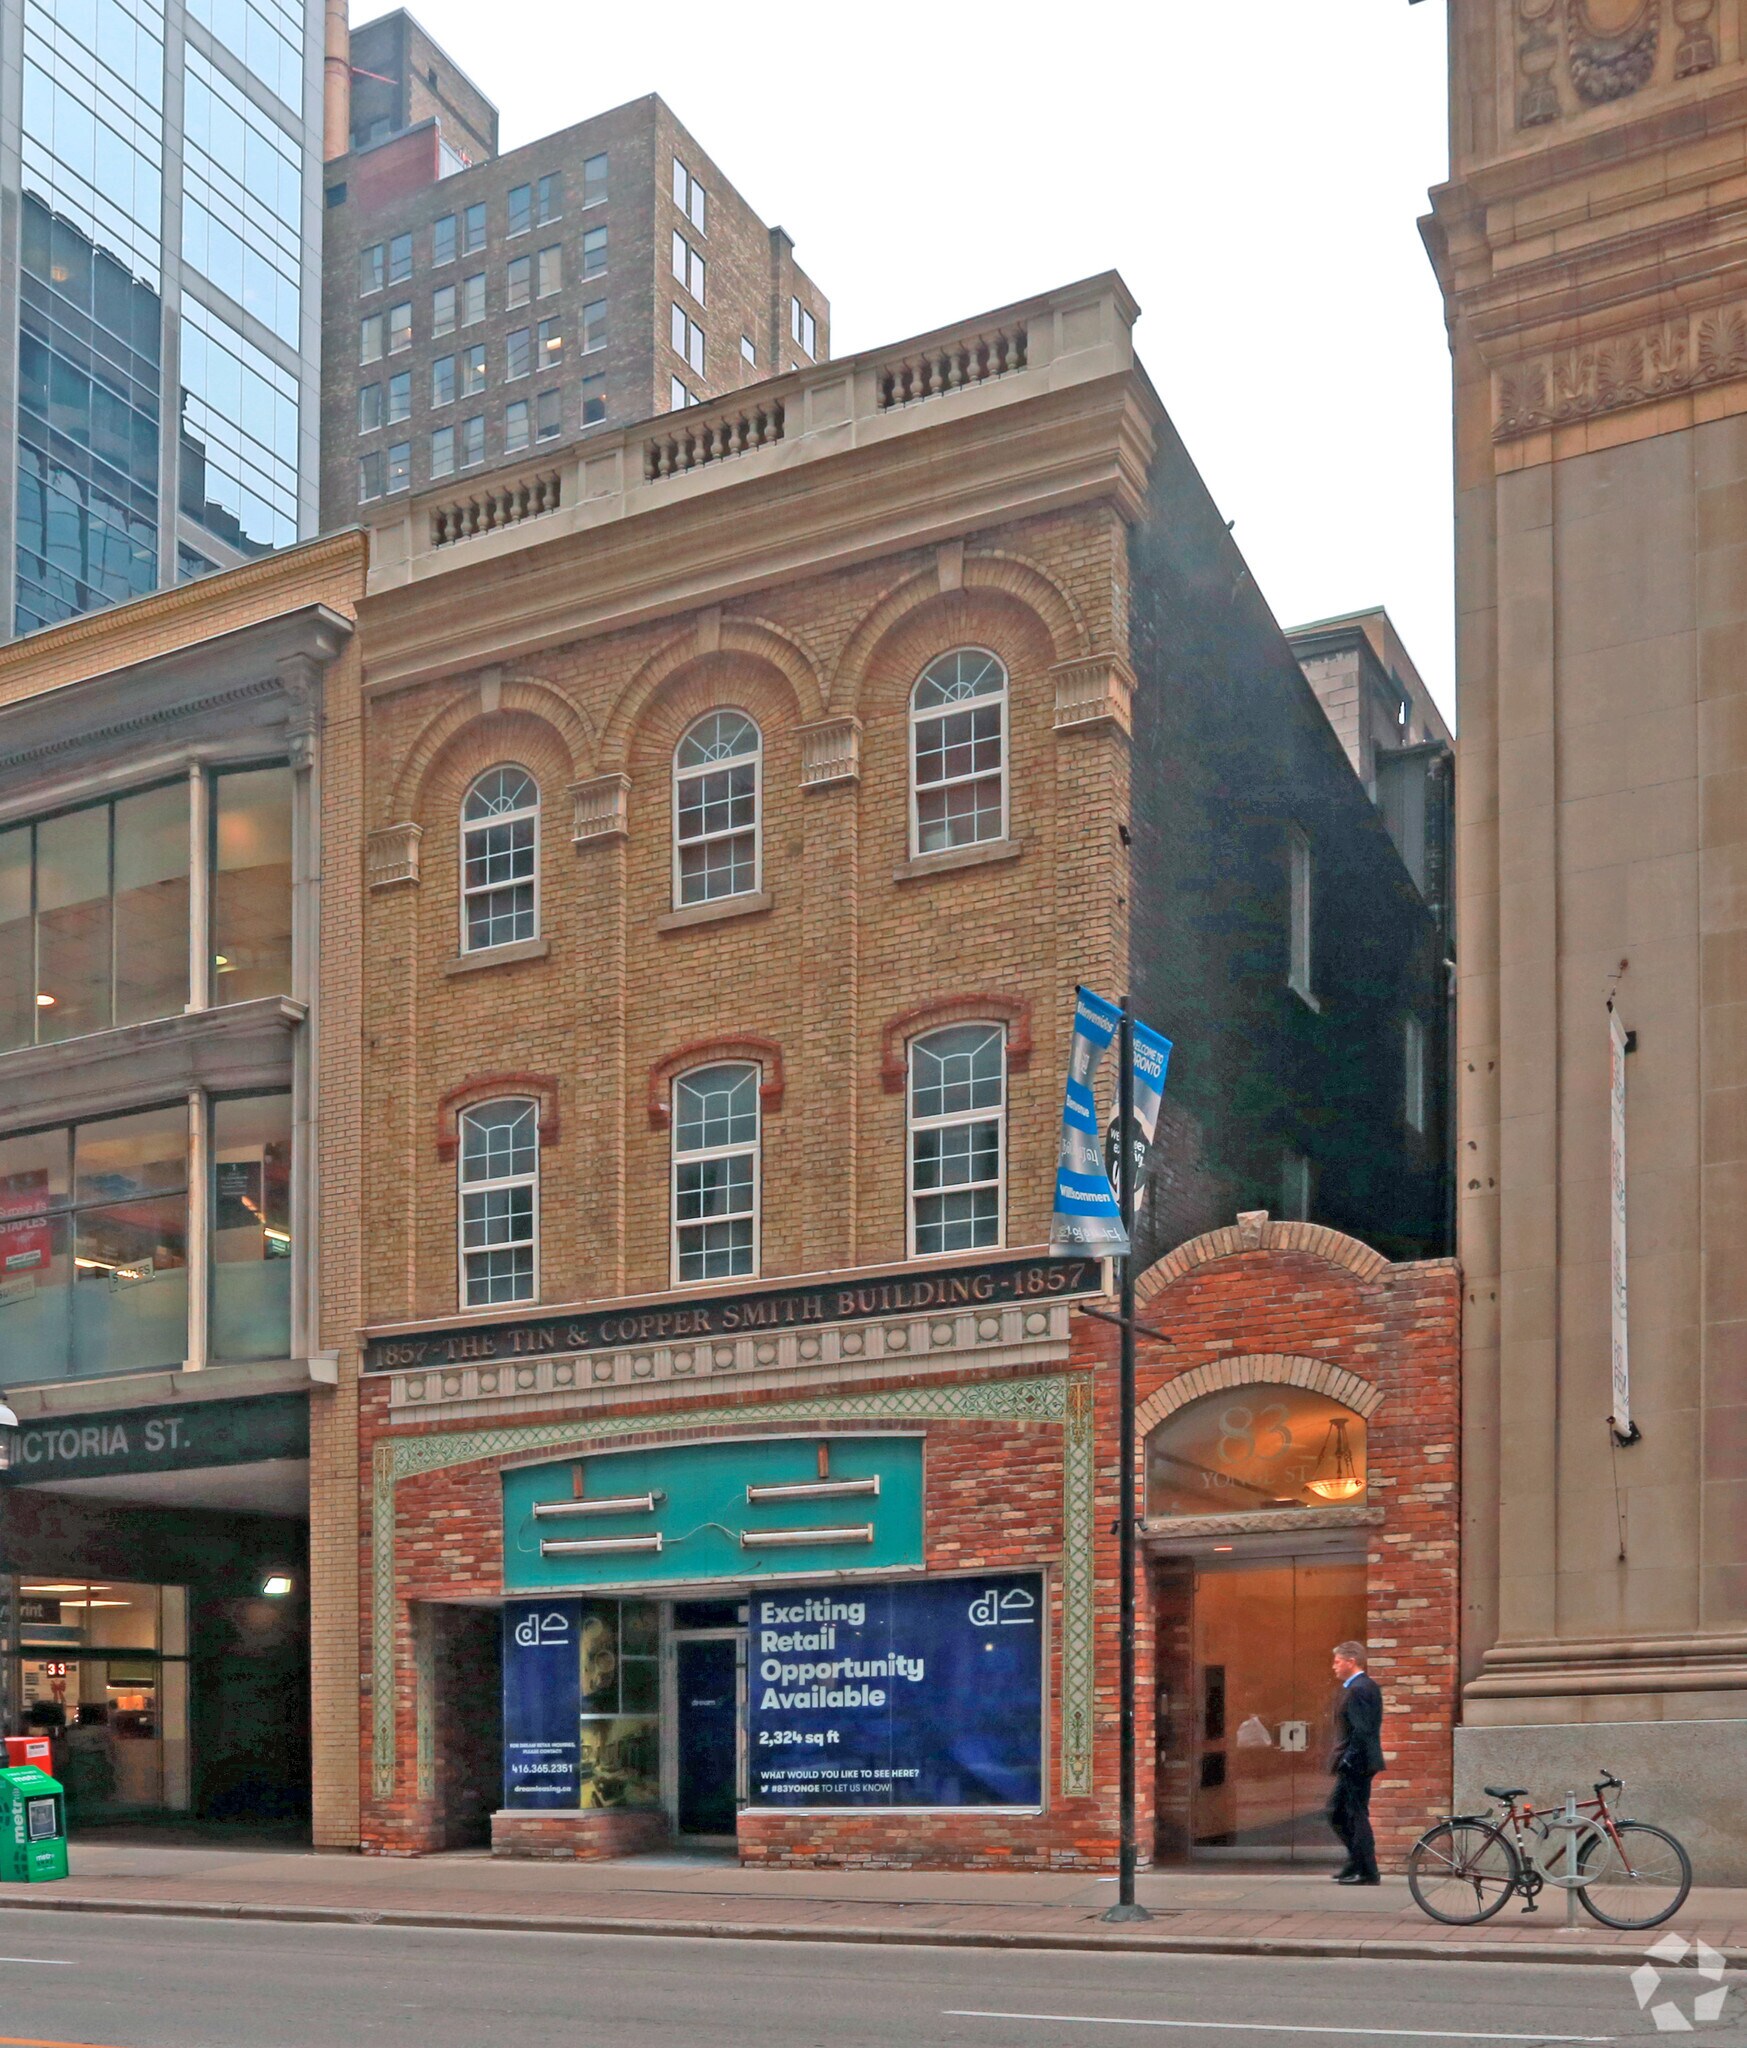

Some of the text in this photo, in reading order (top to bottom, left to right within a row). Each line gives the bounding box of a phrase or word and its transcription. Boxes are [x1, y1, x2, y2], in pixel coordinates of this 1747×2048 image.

[1133, 1051, 1161, 1078] ORONTO
[1155, 1051, 1164, 1064] TO
[1060, 1184, 1111, 1202] Willkommen
[507, 1328, 555, 1352] TIN
[567, 1324, 589, 1346] &
[601, 1308, 712, 1342] COPPER
[722, 1294, 824, 1328] SMITH
[145, 1418, 190, 1451] ST.
[1218, 1404, 1293, 1464] 83
[1201, 1468, 1276, 1489] YONE
[761, 1597, 866, 1625] Exciting
[761, 1626, 836, 1652] Retail
[760, 1652, 924, 1686] Opportunity
[760, 1684, 886, 1709] Available
[759, 1730, 840, 1747] 2,324 sq ft
[512, 1764, 573, 1773] 416.365.2351
[760, 1769, 919, 1779] WHAT WOULD YOU LIKE TO SEE HERE?
[514, 1785, 572, 1794] dreamleasing.ca
[771, 1785, 820, 1793] #83YONGE
[835, 1784, 847, 1792] LET
[850, 1784, 860, 1792] US
